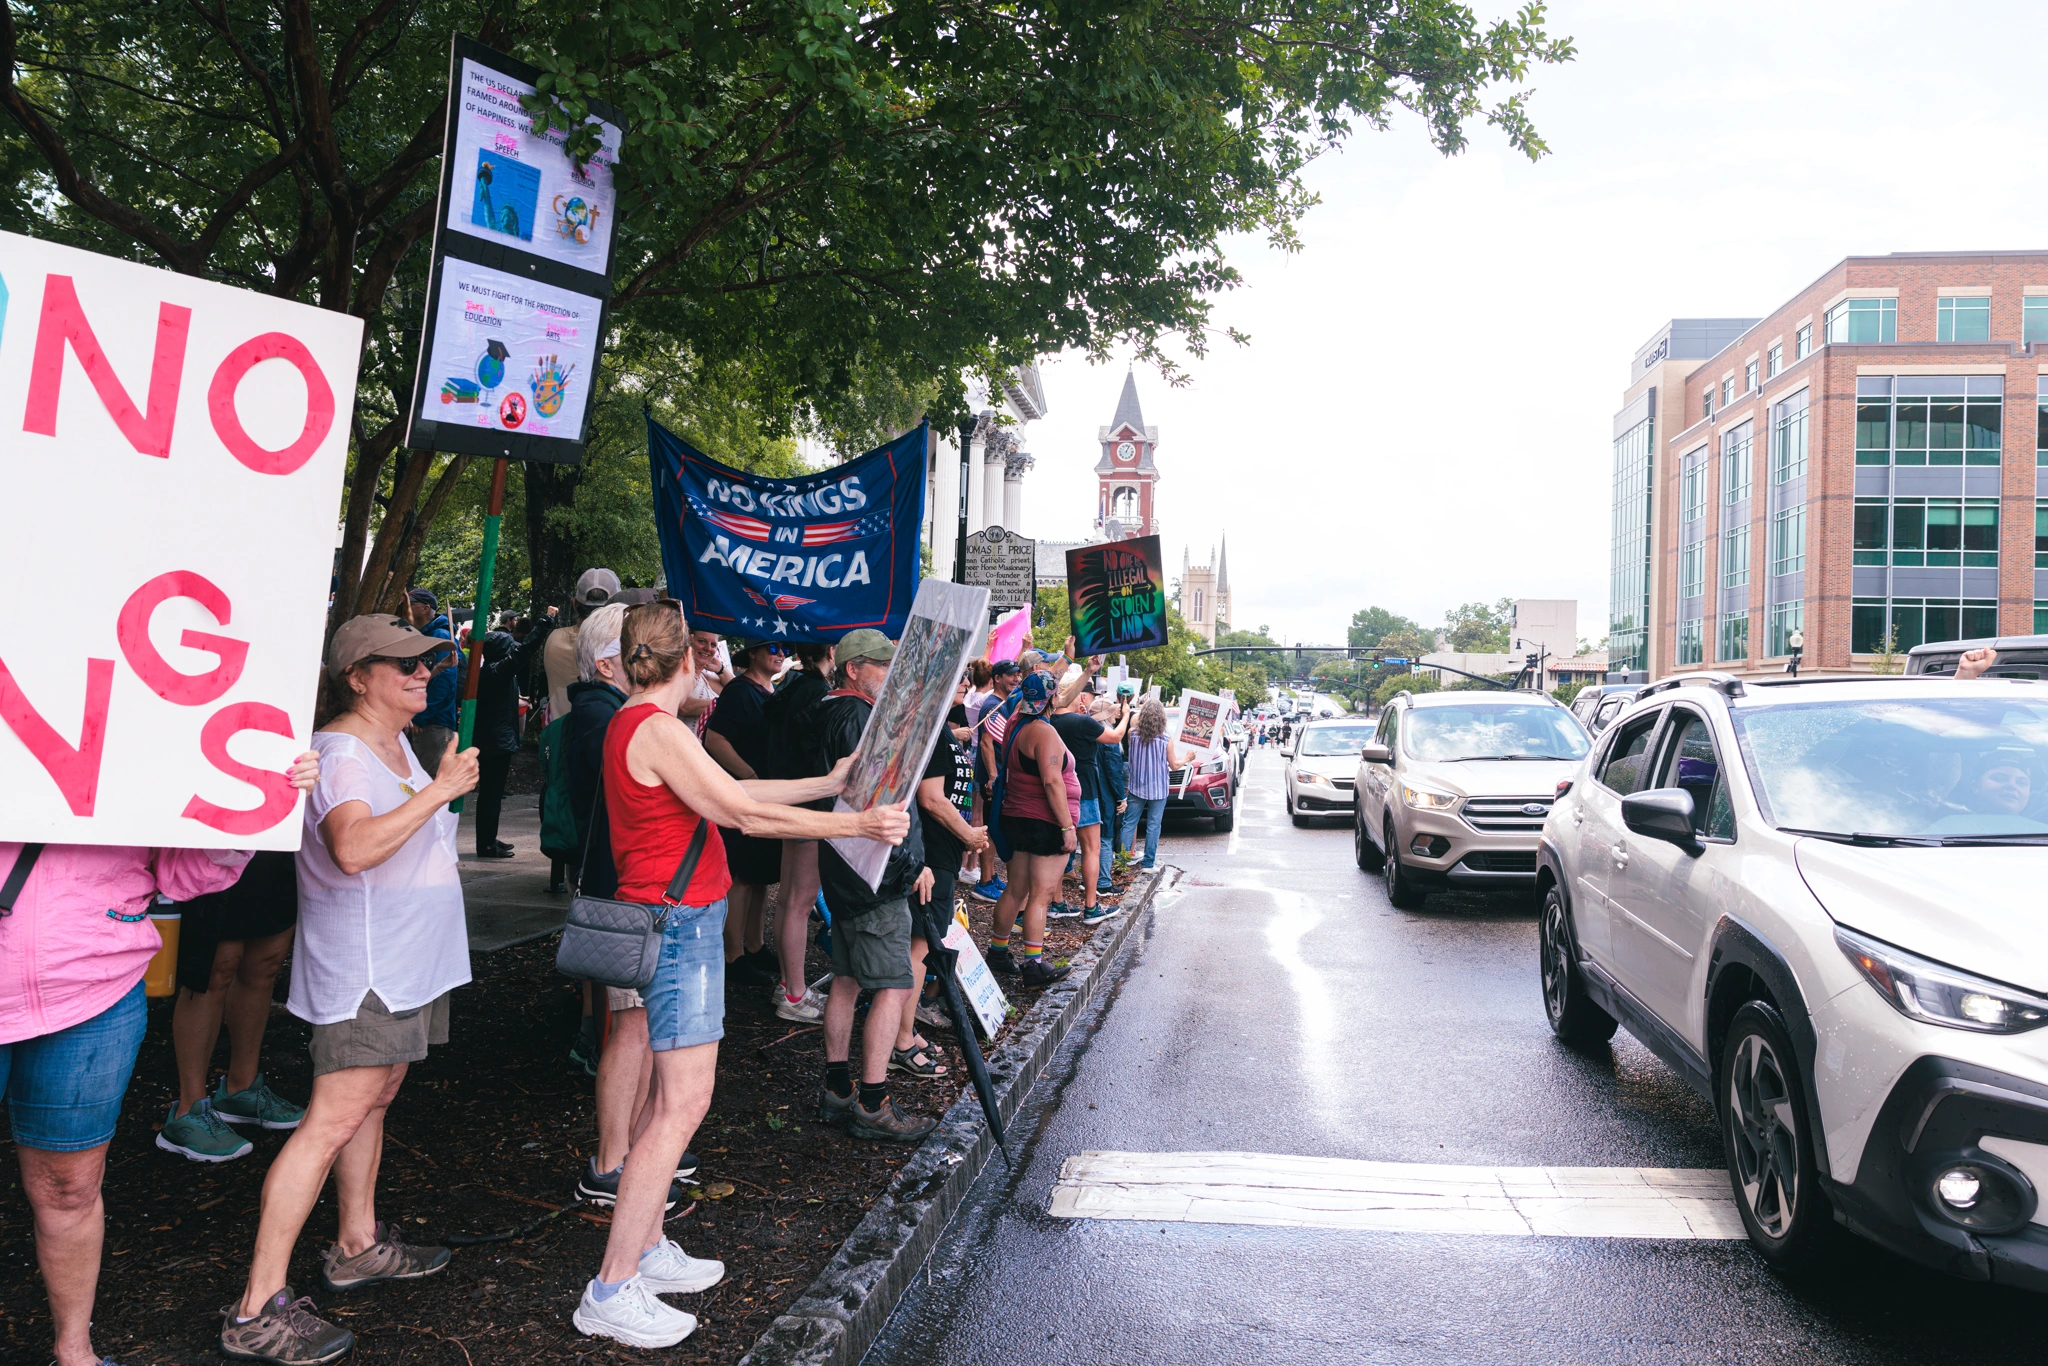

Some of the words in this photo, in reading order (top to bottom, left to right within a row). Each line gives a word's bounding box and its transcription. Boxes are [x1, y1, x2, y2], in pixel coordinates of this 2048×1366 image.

[470, 71, 484, 84] THE
[486, 78, 496, 88] US
[467, 86, 498, 105] FRAMED
[499, 100, 529, 117] AROUND
[466, 102, 476, 112] OF
[517, 122, 529, 133] WE
[549, 136, 567, 149] FIGHT
[494, 143, 519, 158] SPEECH
[458, 281, 470, 292] WE
[471, 284, 491, 297] MUST
[491, 290, 510, 302] FIGHT
[510, 295, 523, 305] FOR
[524, 298, 536, 309] THE
[536, 302, 571, 318] PROTECTION
[464, 311, 502, 327] EDUCATION
[545, 331, 561, 341] ARTS
[22, 272, 336, 475] NO
[707, 477, 758, 513] NO
[758, 475, 868, 517] KINGS
[775, 526, 798, 544] IN
[1008, 545, 1032, 555] PRICE
[1103, 550, 1118, 572] NO
[1119, 552, 1134, 571] ONE
[698, 534, 872, 589] AMERICA
[998, 564, 1032, 573] Missionary
[985, 571, 1021, 579] Co-founder
[1107, 567, 1147, 589] ILLEGAL
[1121, 584, 1133, 597] ON
[1110, 592, 1150, 618] STOLEN
[1110, 613, 1145, 643] LAND
